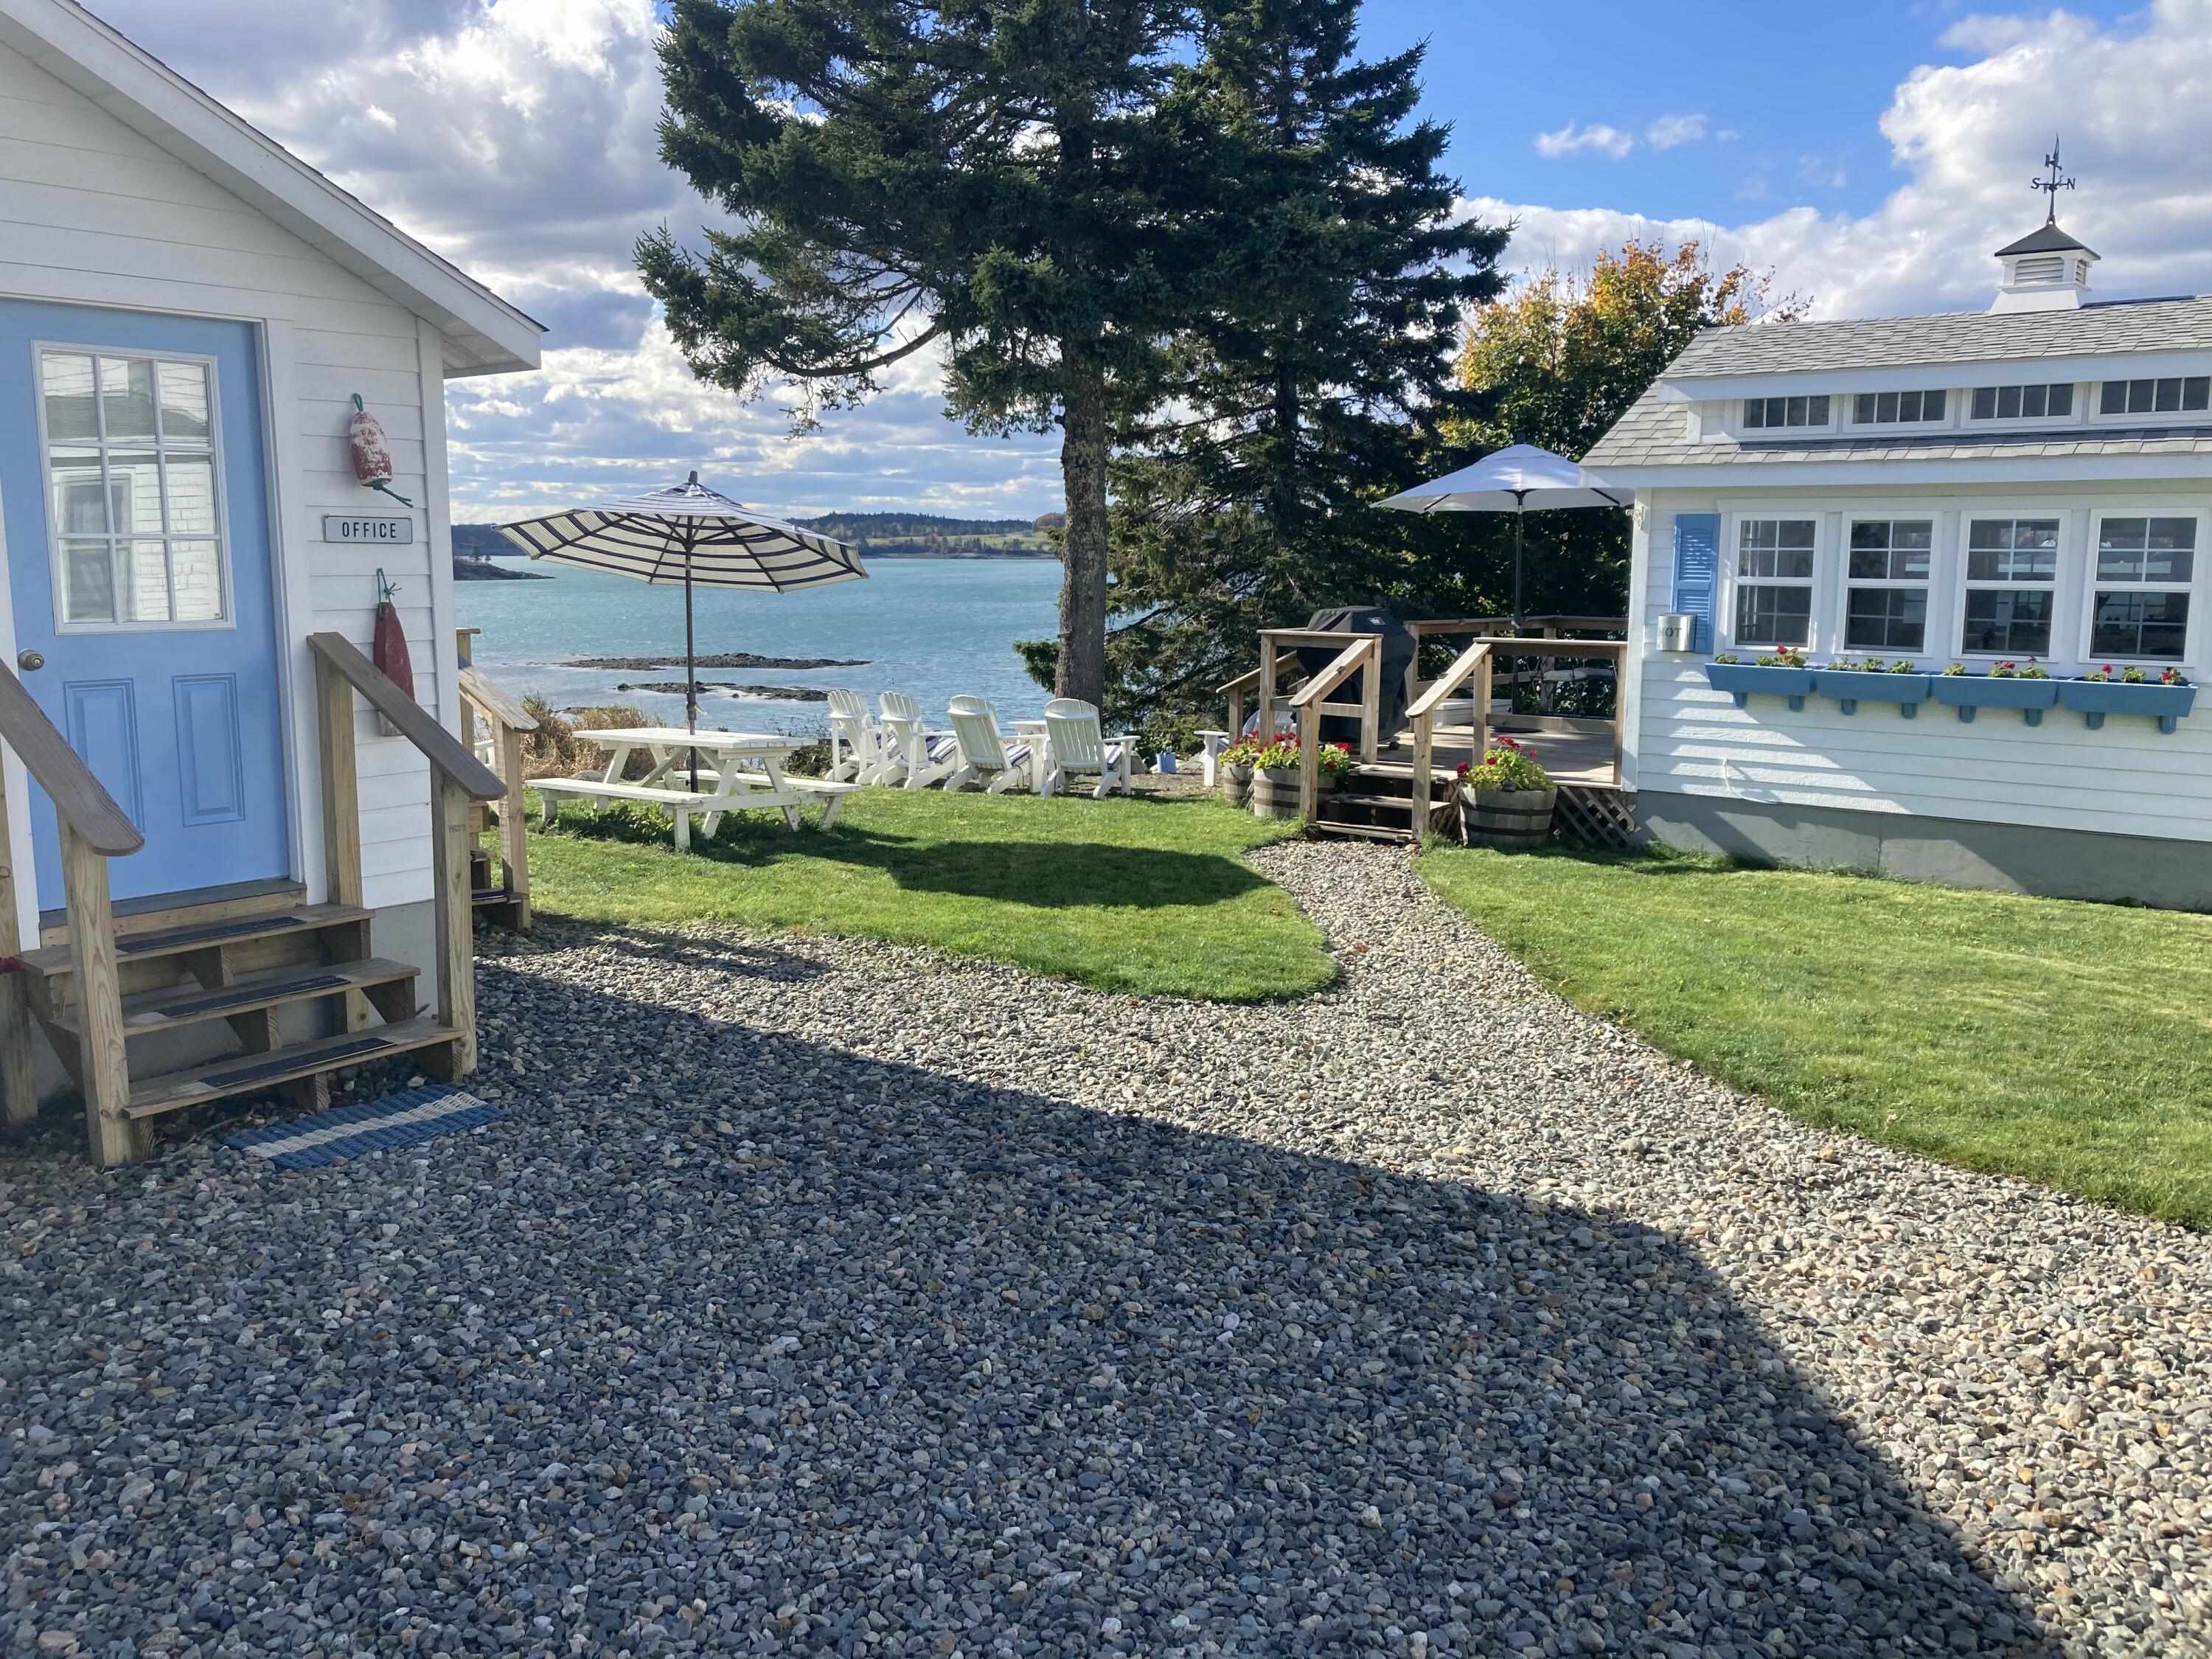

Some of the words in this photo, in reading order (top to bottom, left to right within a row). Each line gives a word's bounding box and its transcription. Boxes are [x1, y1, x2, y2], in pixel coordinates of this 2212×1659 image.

[2031, 178, 2040, 189] S
[2067, 178, 2076, 189] N
[342, 522, 397, 538] OFFICE
